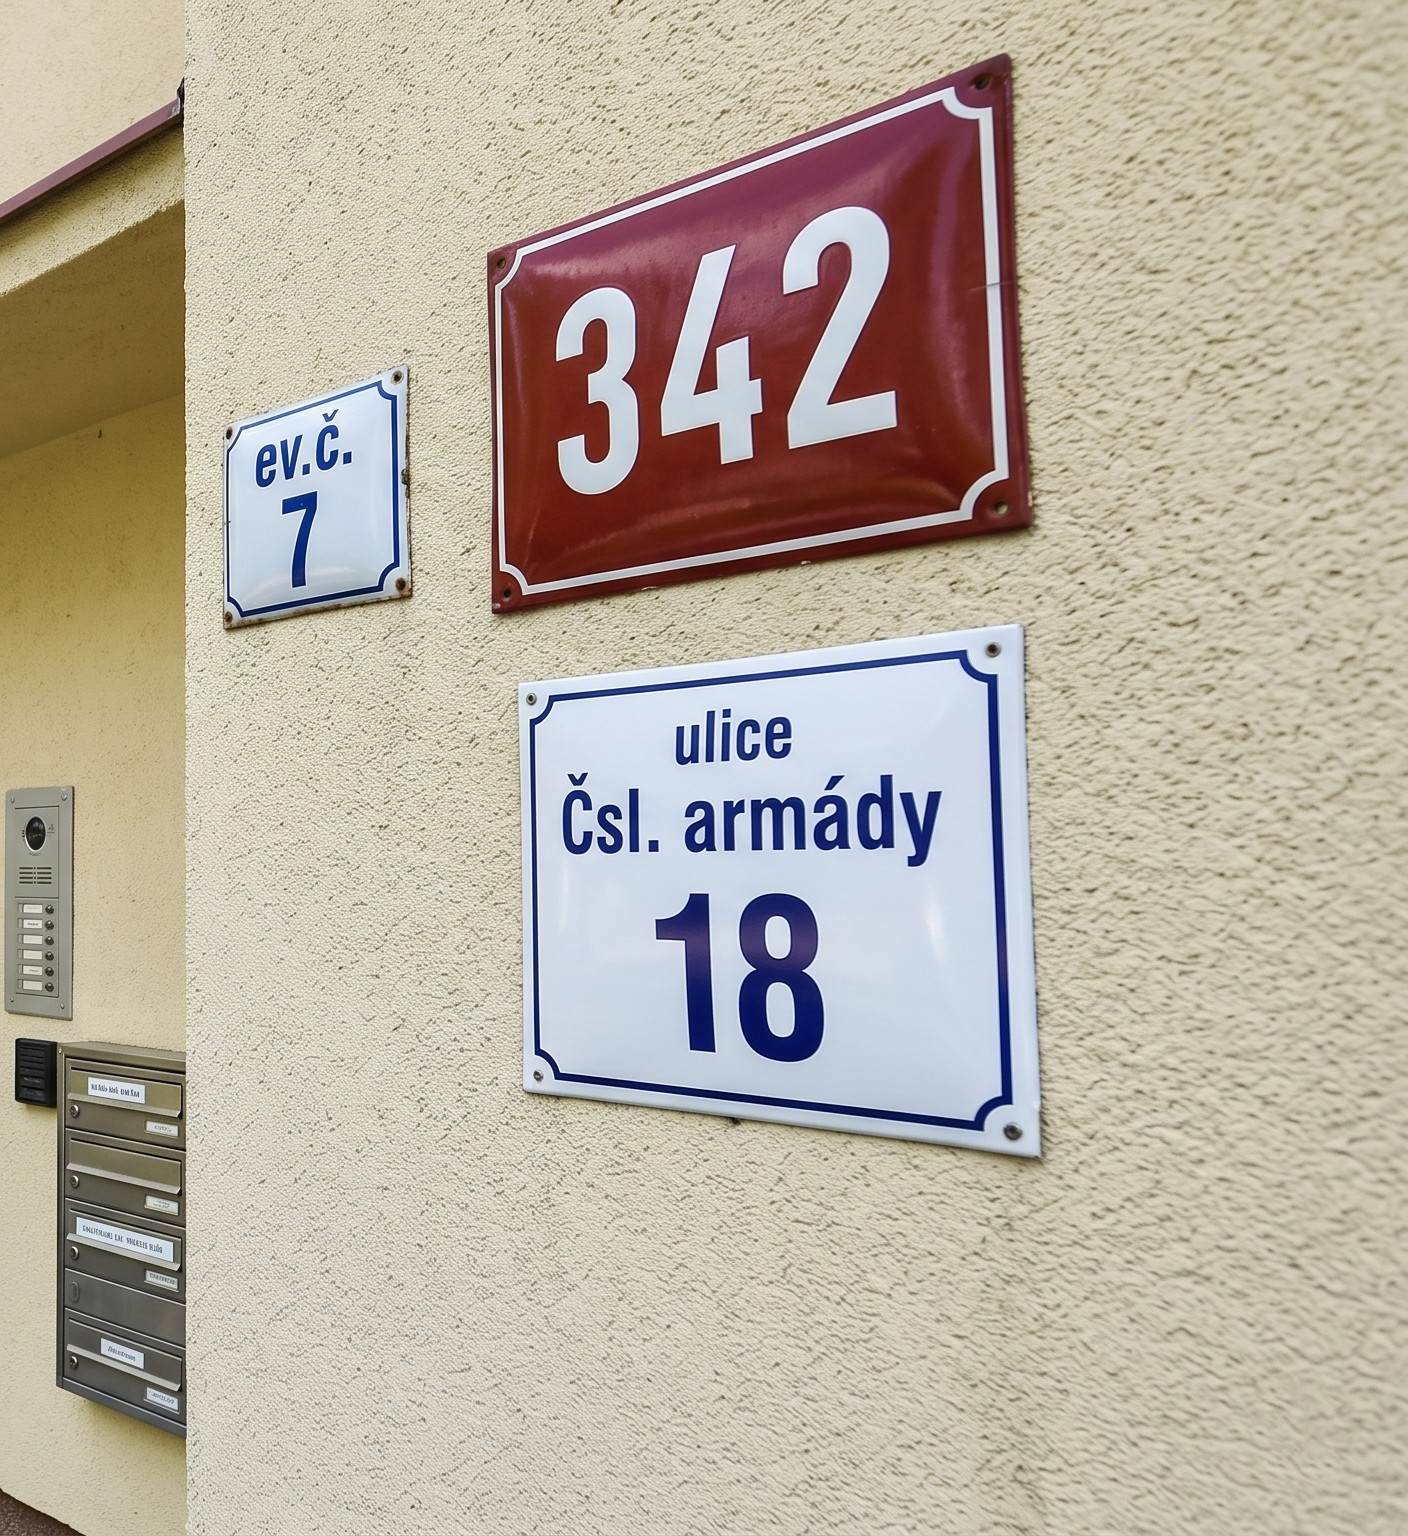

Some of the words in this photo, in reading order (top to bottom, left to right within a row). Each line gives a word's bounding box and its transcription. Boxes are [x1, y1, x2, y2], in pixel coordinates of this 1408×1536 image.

[555, 206, 898, 495] 342
[255, 408, 353, 488] ev.č.
[281, 490, 318, 589] 7
[675, 708, 792, 766] ulice
[562, 772, 660, 855] Čsl.
[684, 774, 943, 868] armády
[654, 892, 825, 1063] 18
